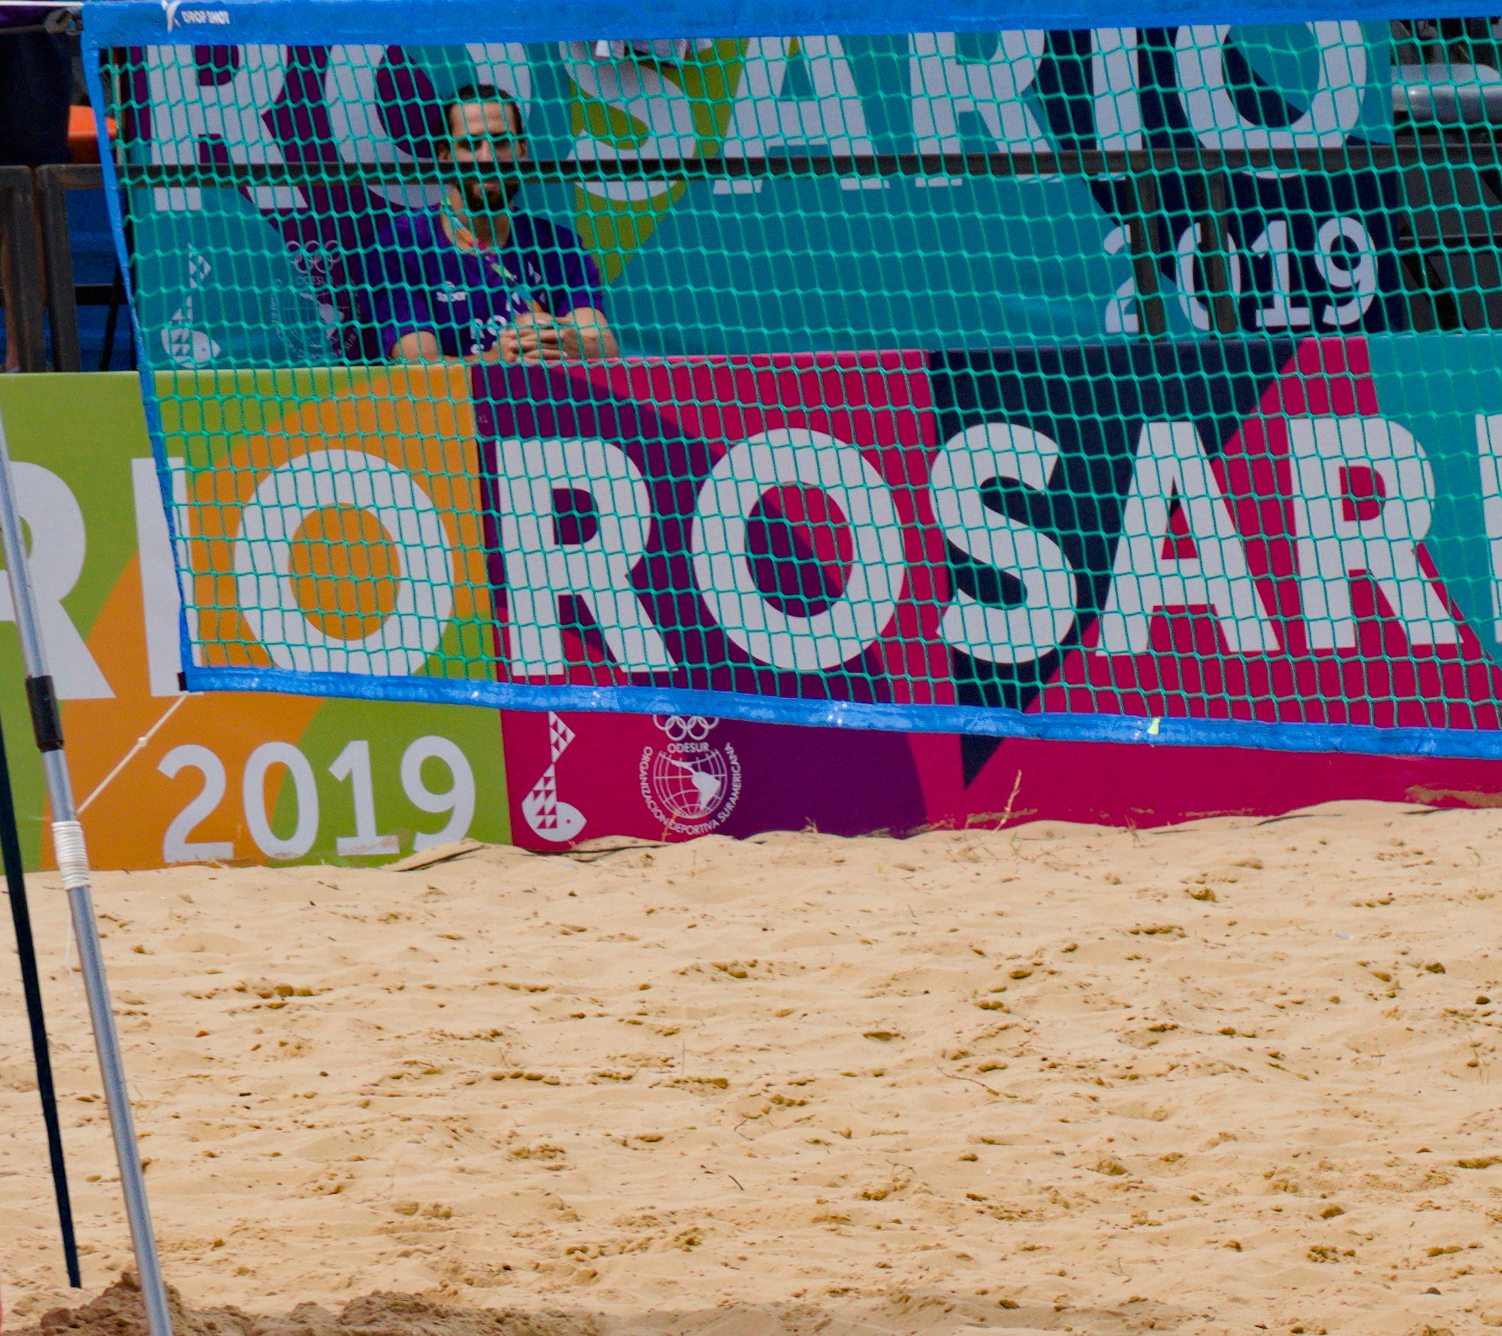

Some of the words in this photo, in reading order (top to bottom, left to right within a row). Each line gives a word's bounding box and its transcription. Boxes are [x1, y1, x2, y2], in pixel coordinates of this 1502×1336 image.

[1102, 214, 1380, 336] 2019
[156, 734, 476, 863] 2019
[666, 741, 710, 754] ODESUR
